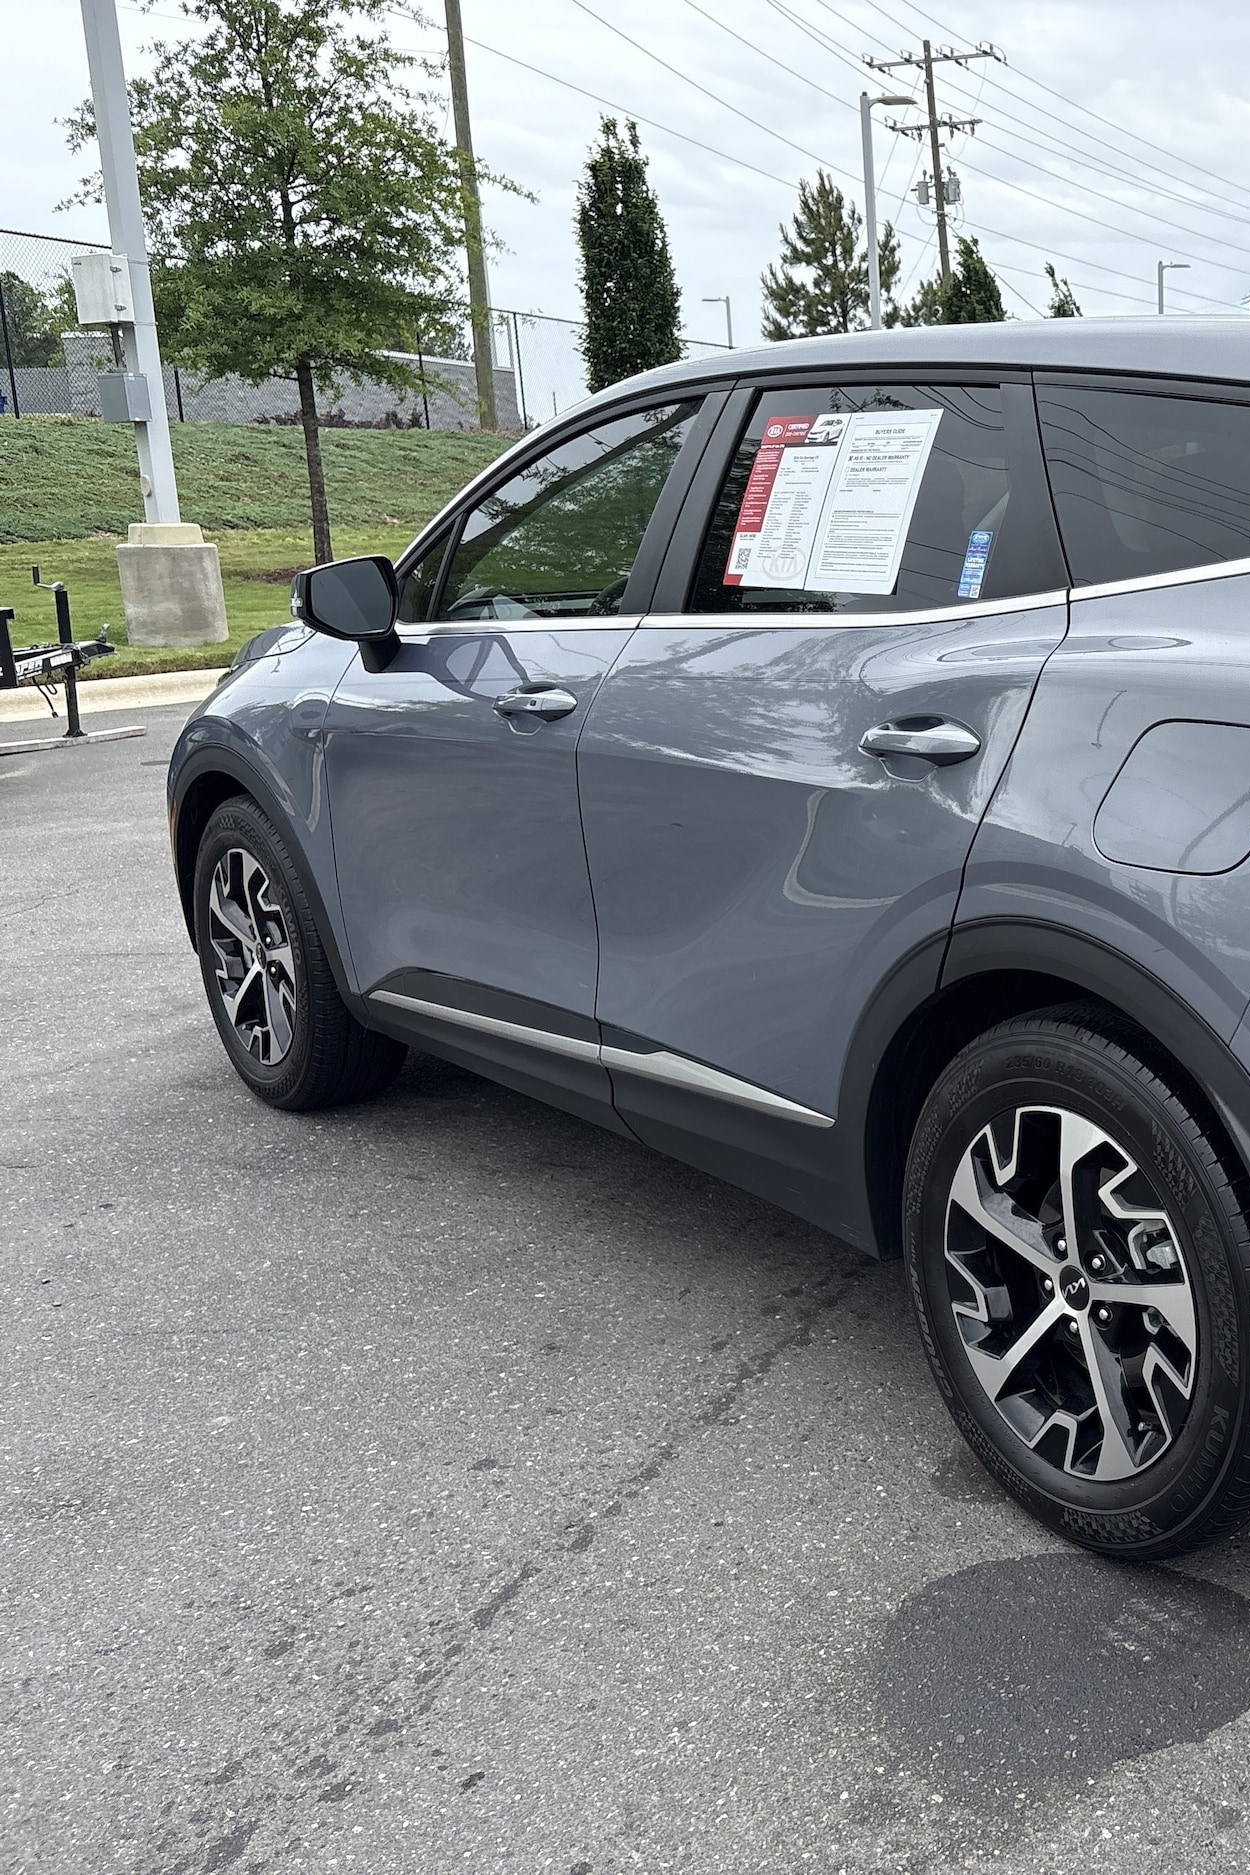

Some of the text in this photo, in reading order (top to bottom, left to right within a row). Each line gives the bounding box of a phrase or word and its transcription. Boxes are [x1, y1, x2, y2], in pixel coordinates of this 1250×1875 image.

[787, 423, 810, 431] CERTIFIED
[277, 883, 302, 966] KUMHO
[1005, 1055, 1051, 1070] 235/60
[1170, 1404, 1229, 1512] KUMHO
